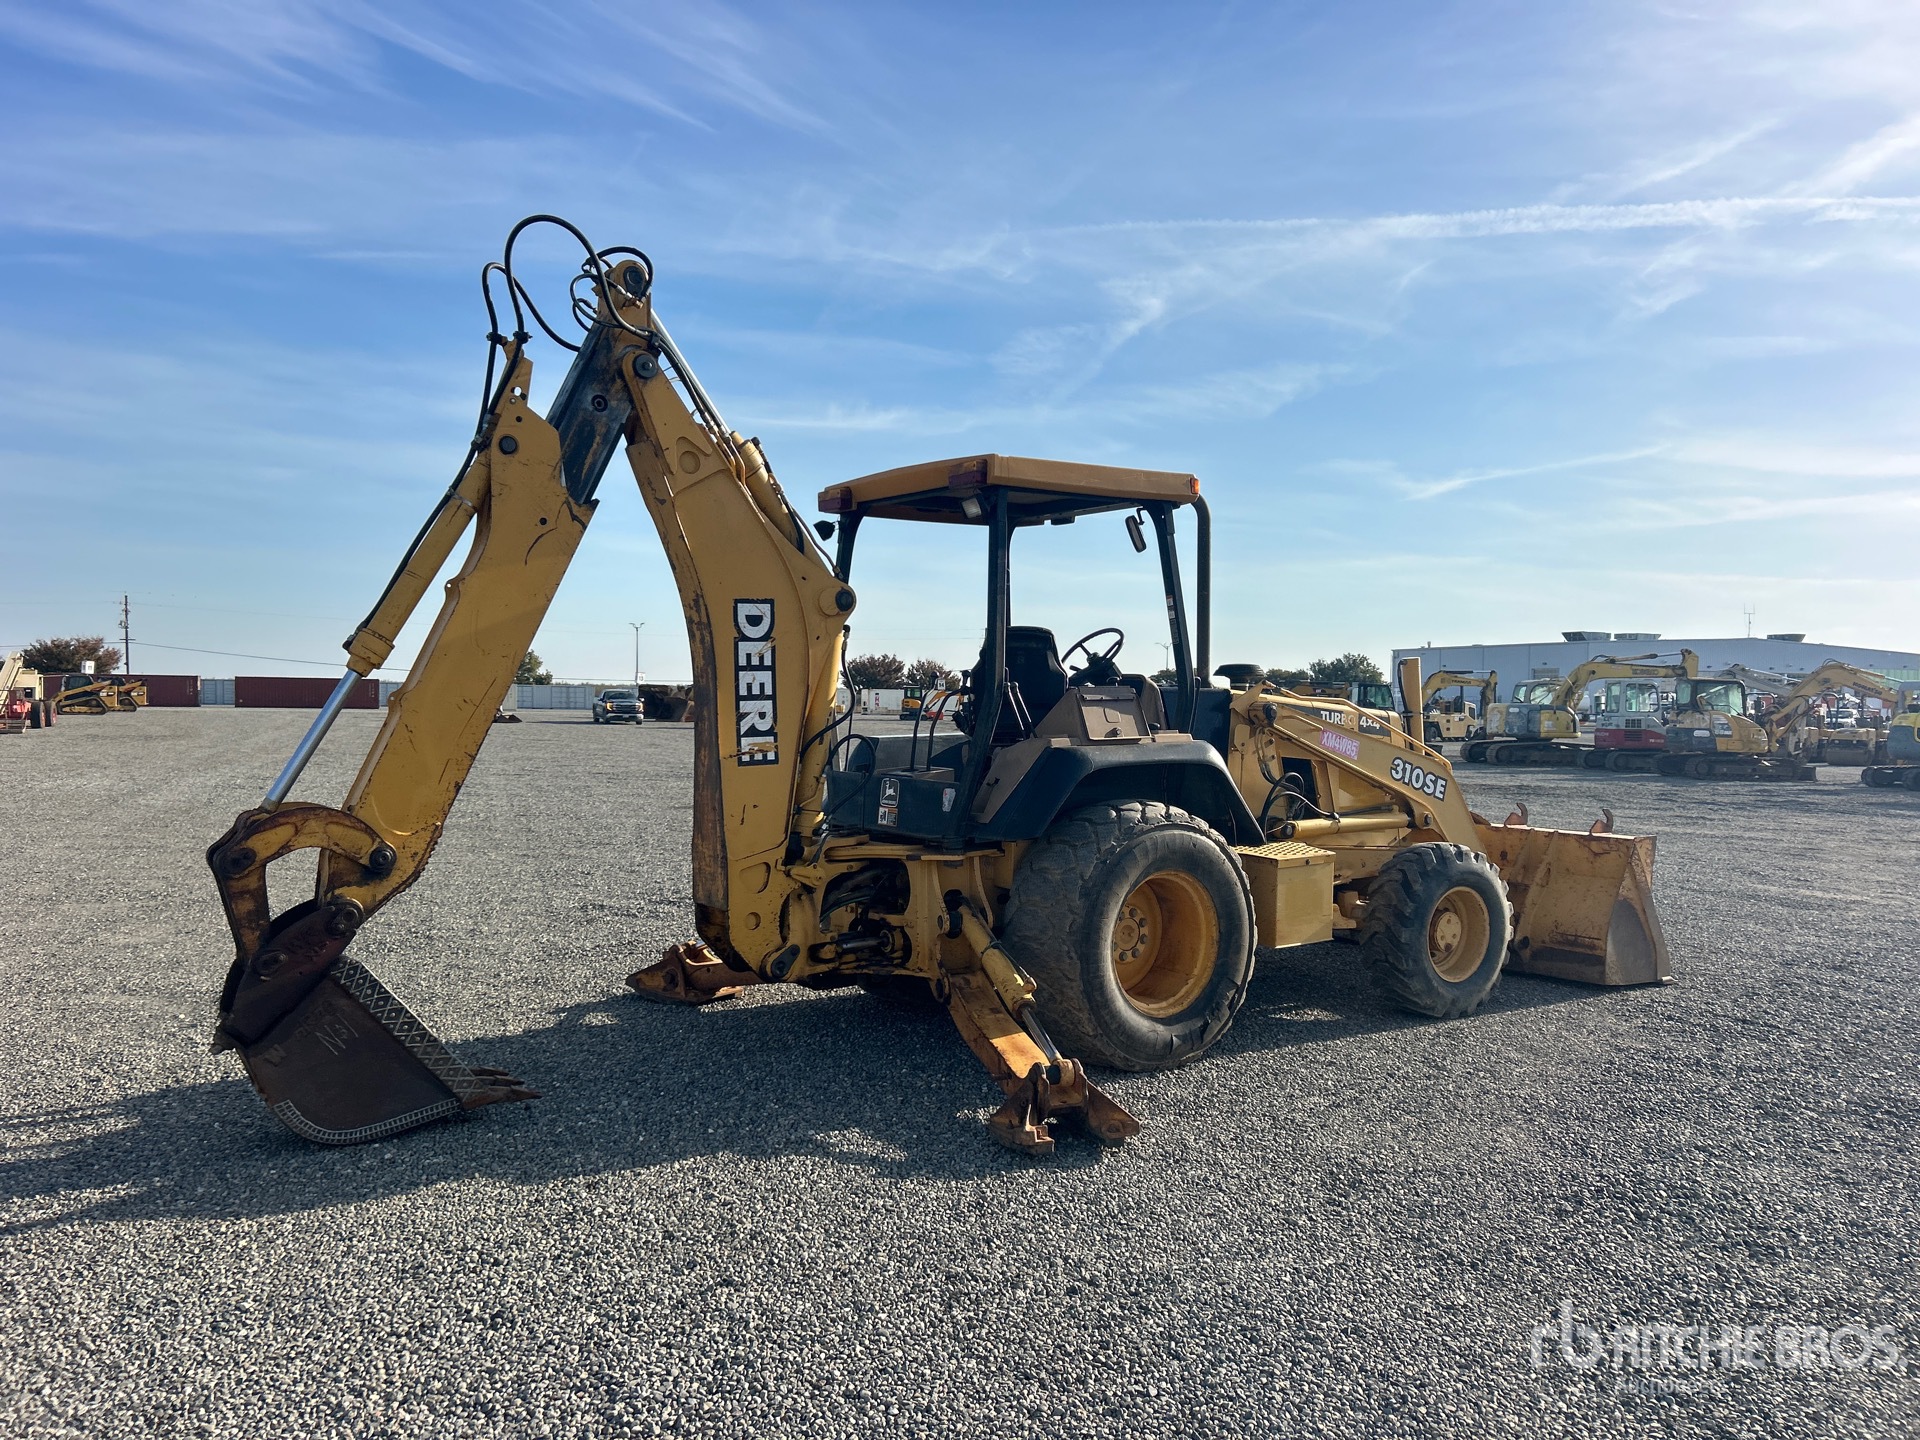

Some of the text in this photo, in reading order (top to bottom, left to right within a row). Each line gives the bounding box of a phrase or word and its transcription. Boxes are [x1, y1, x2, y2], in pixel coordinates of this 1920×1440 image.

[735, 600, 778, 764] DEERE
[1321, 731, 1359, 757] XM4W85
[1391, 758, 1447, 800] 310SE
